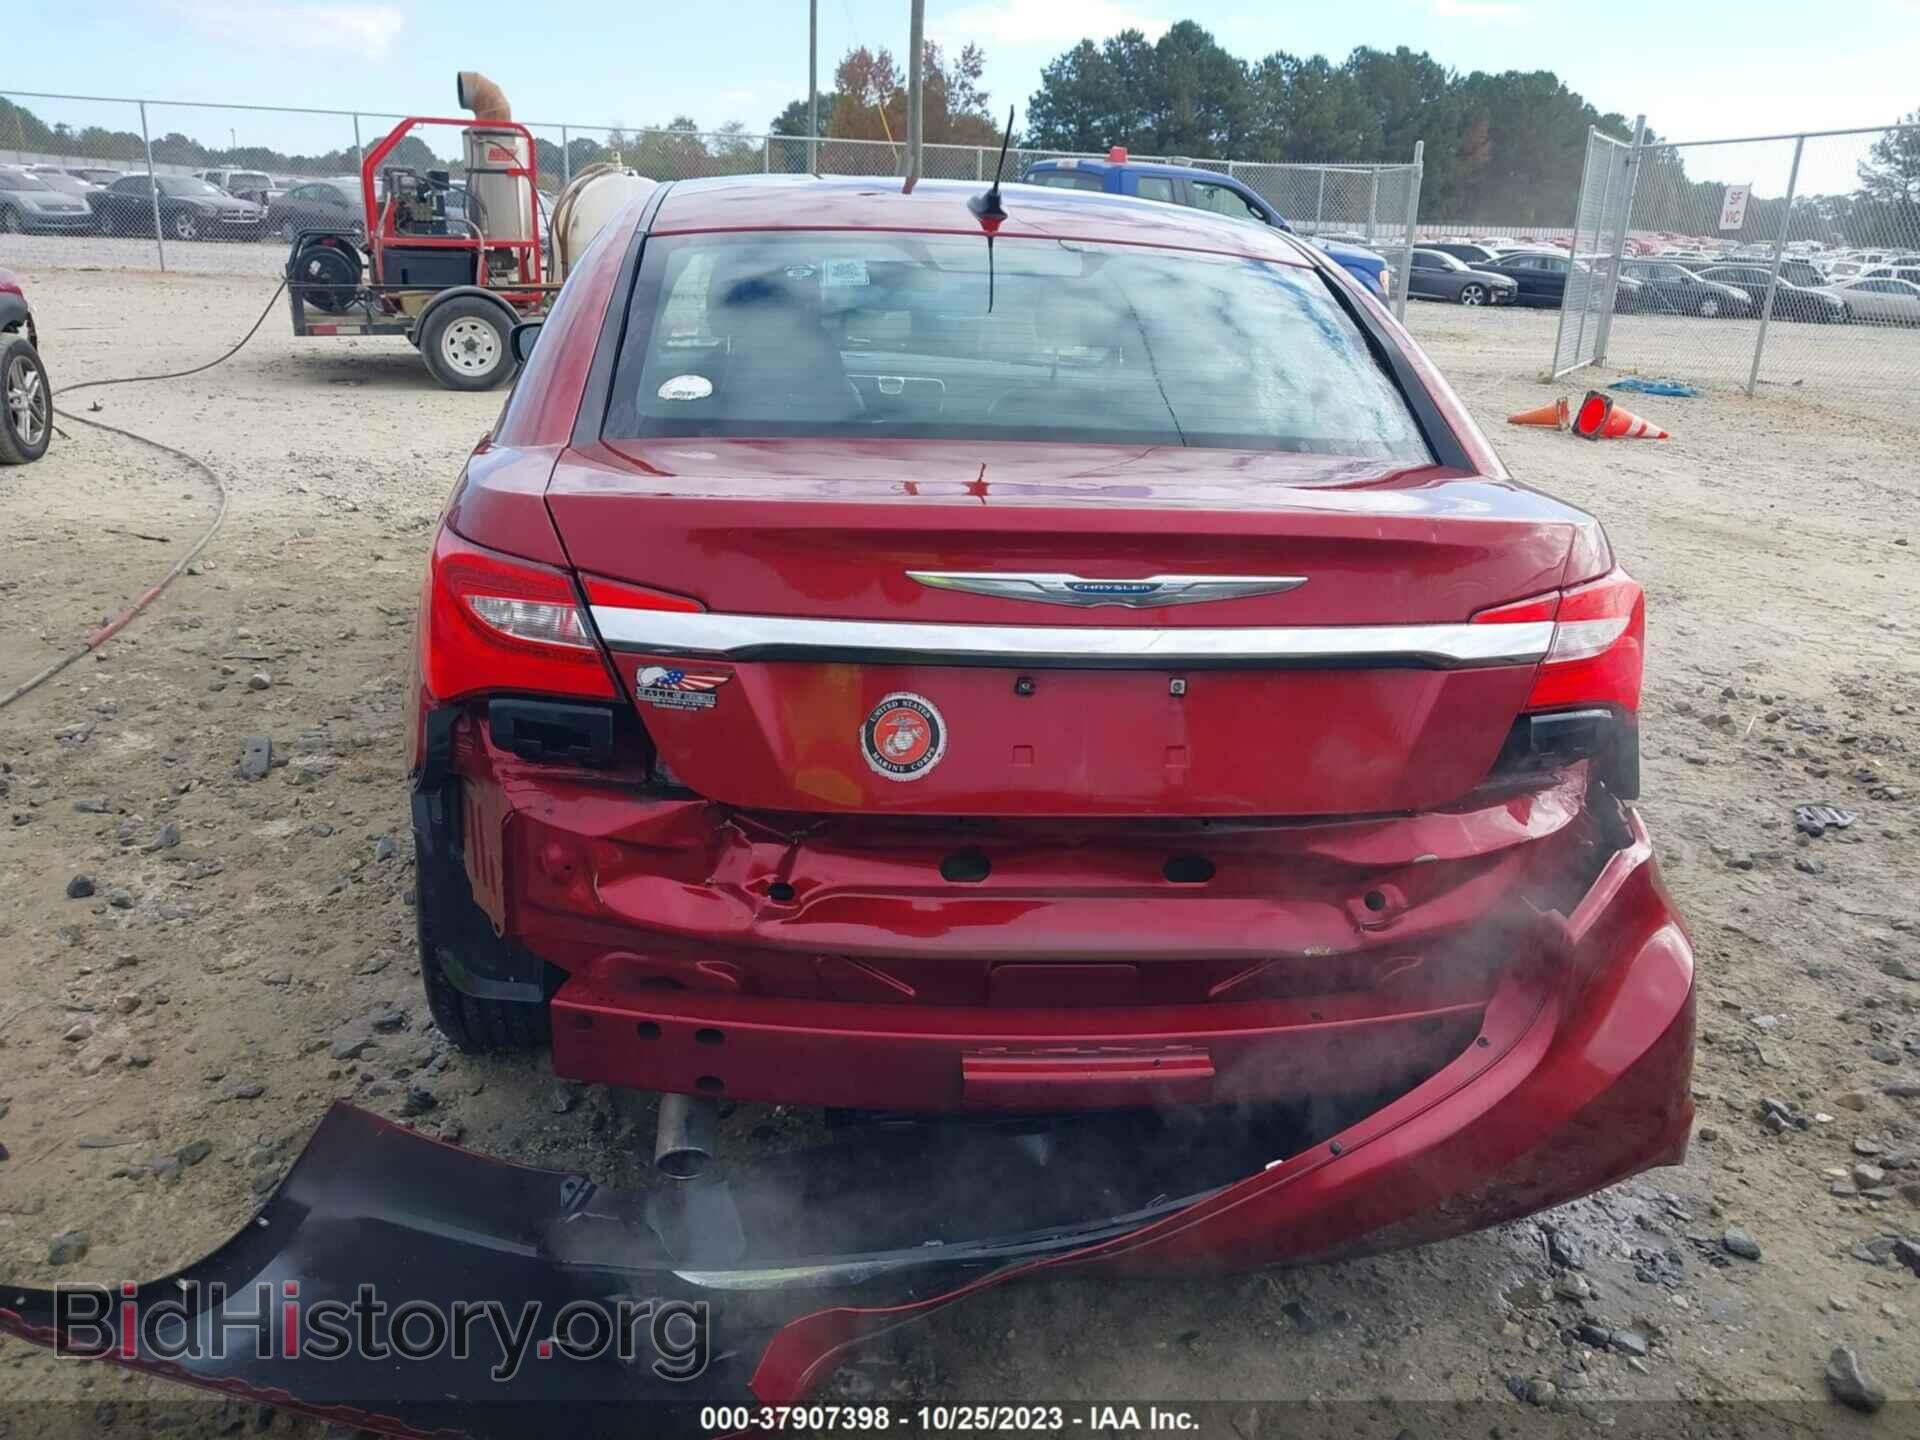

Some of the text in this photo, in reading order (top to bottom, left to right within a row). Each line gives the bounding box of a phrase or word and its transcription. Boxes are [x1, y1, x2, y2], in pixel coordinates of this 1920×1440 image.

[1073, 583, 1151, 591] CHRYSLER
[870, 700, 931, 722] UNITED STATES
[871, 746, 936, 773] MARINE CORPS
